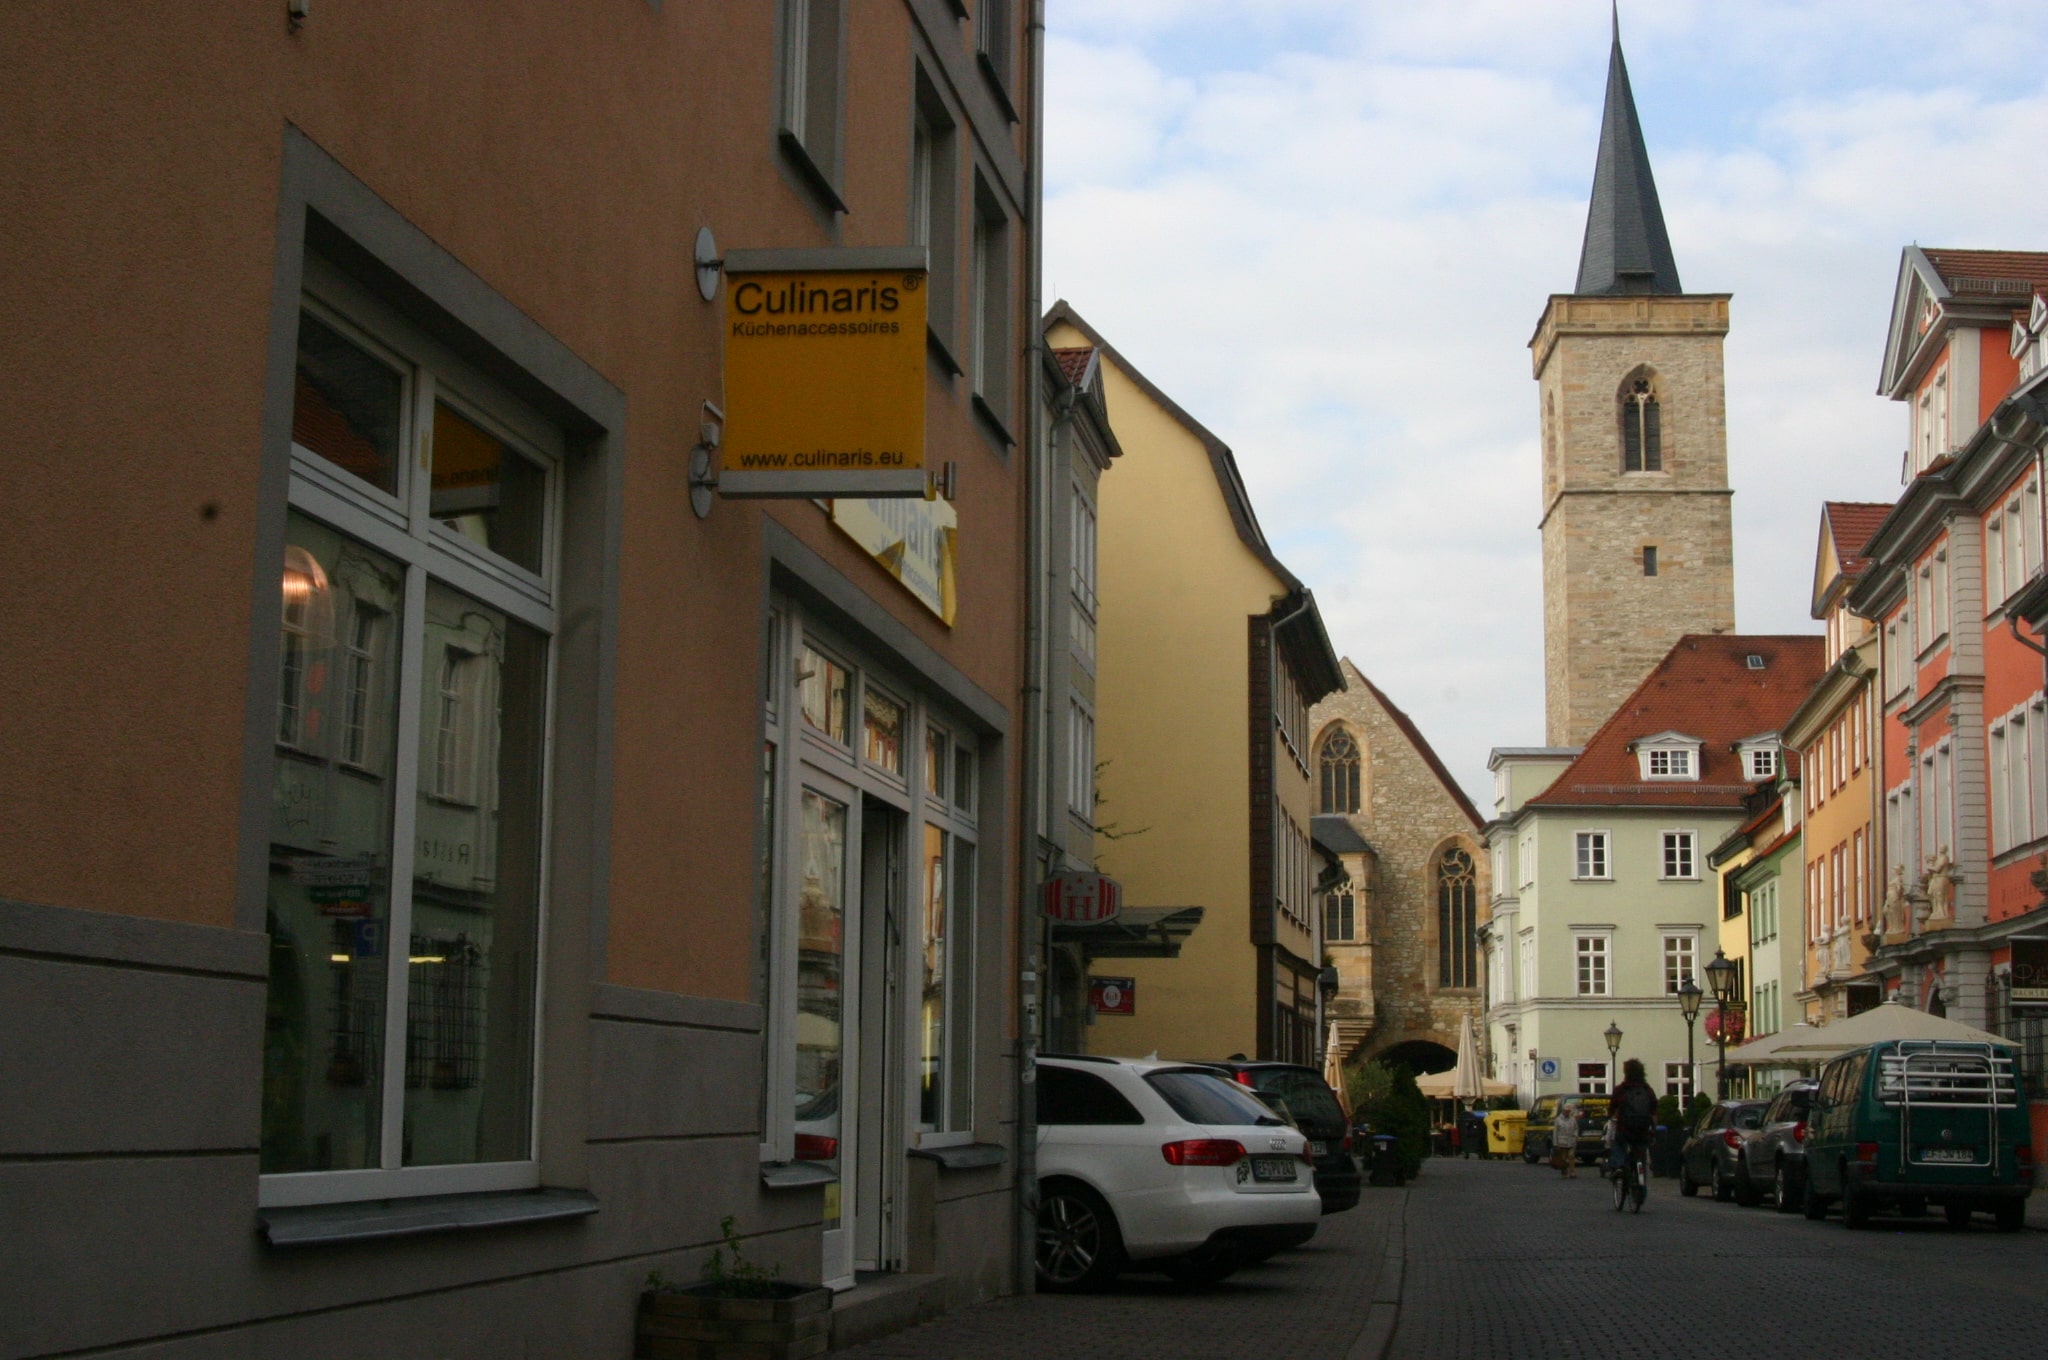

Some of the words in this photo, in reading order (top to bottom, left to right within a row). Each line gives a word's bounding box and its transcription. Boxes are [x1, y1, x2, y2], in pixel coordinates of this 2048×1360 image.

[733, 320, 899, 337] Küchenaccessoires
[741, 449, 903, 467] www.culinaris.eu
[1065, 896, 1096, 921] H
